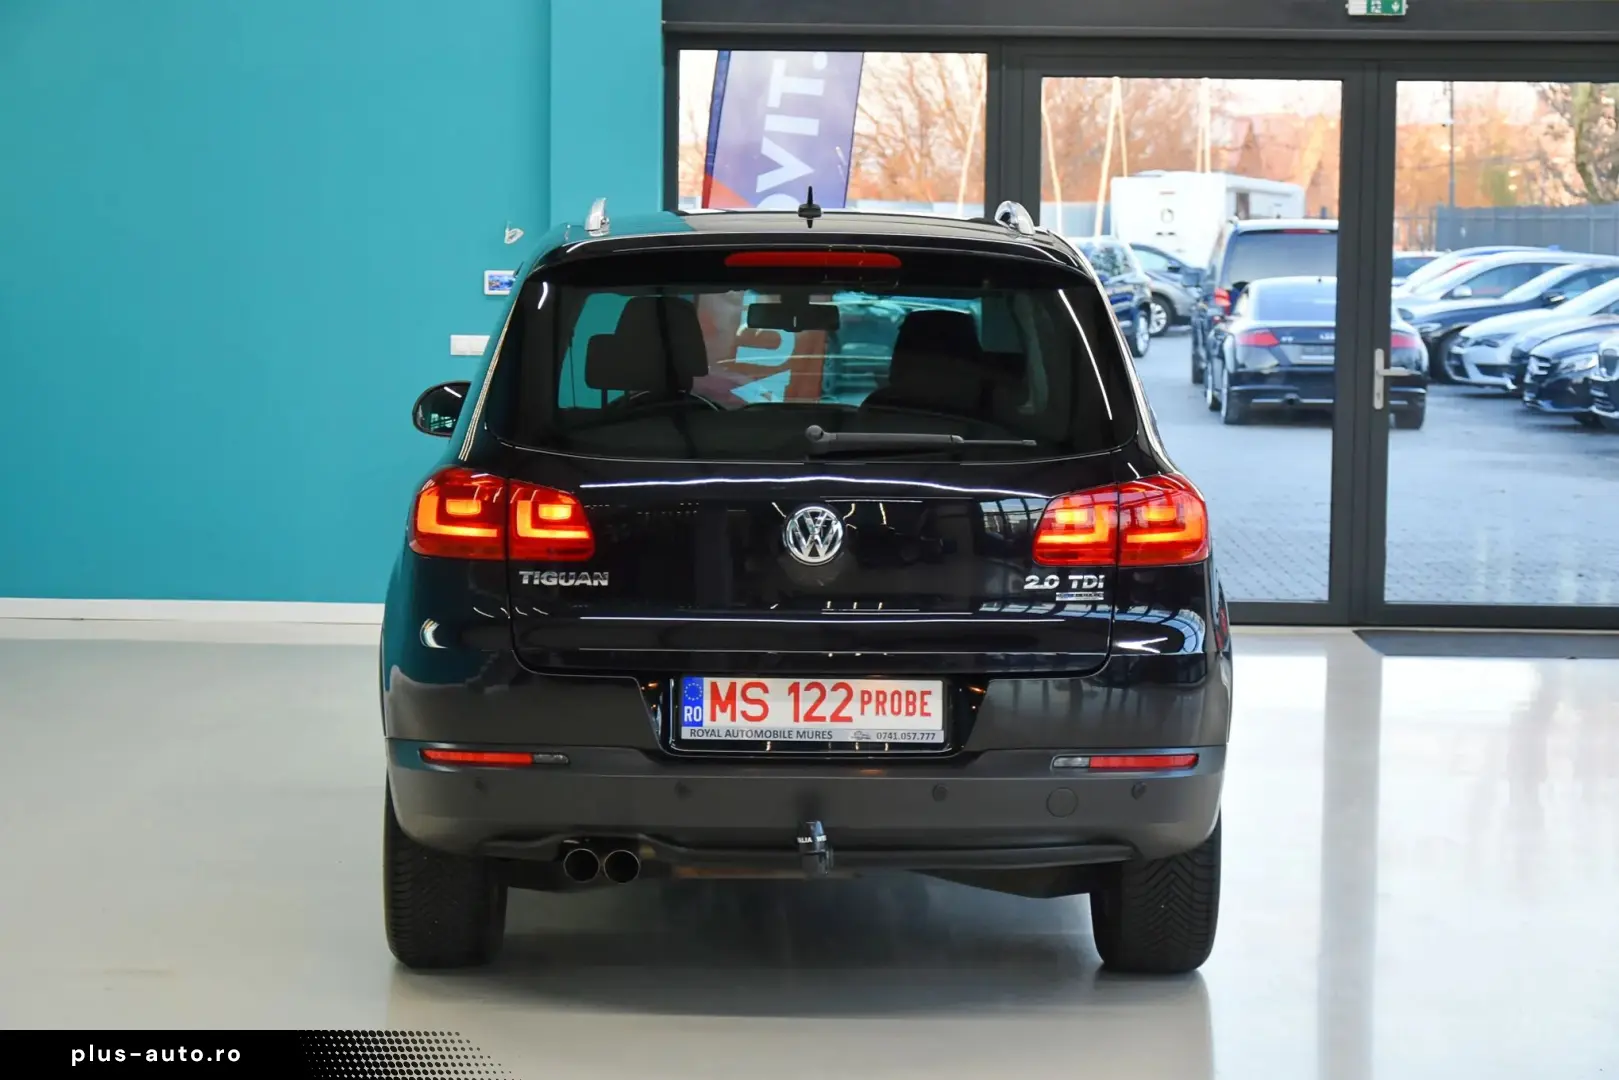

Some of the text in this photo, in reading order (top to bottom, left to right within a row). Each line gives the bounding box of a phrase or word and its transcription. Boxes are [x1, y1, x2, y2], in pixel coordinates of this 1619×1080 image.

[753, 51, 829, 209] VIT.
[518, 570, 609, 587] TIGUAN
[1023, 574, 1105, 590] 2.0 TDI
[709, 681, 933, 723] MS 122 PROBE
[684, 705, 703, 722] RO
[689, 728, 936, 741] ROYAL AUTOMOBILE MURES 0741.057.777
